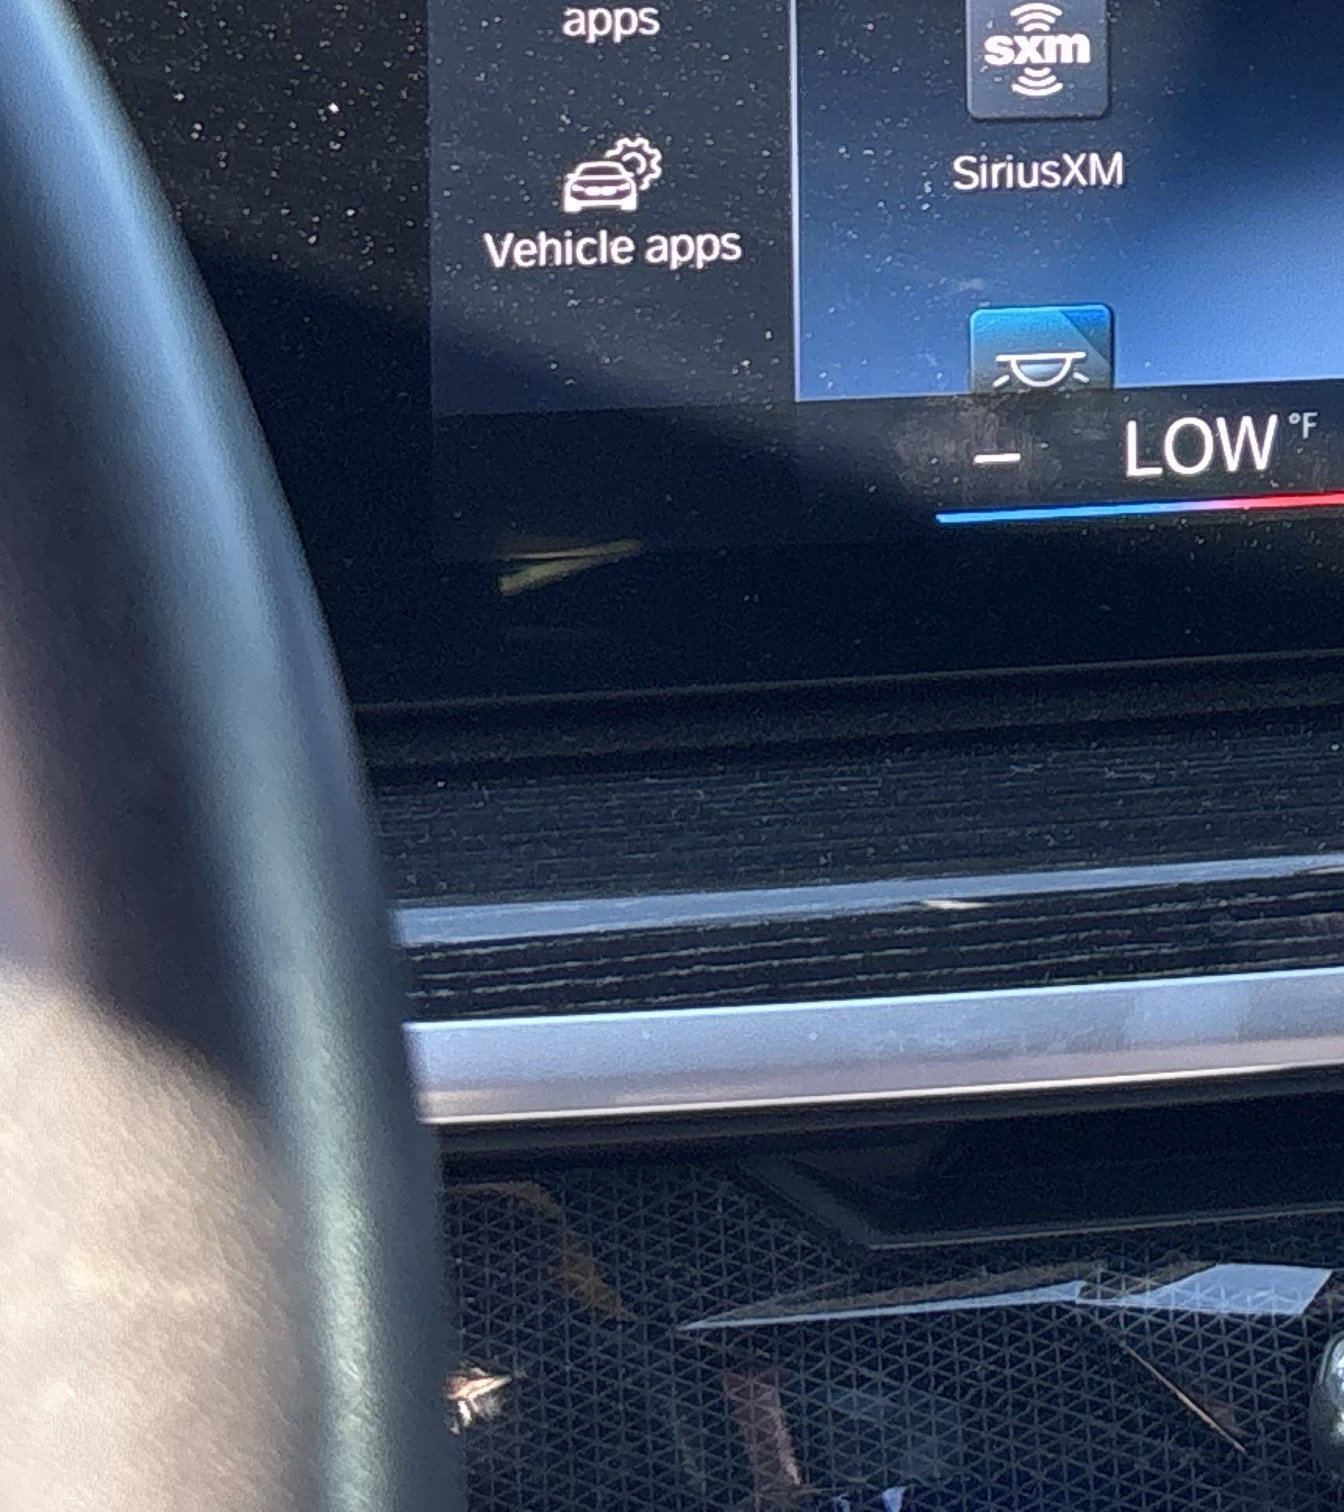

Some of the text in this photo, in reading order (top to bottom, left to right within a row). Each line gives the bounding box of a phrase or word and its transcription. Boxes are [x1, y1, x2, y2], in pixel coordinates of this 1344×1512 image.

[562, 4, 660, 43] apps
[984, 31, 1091, 65] sxm
[953, 152, 1124, 192] SiriusXM
[484, 230, 742, 270] Vehicle apps
[1125, 416, 1278, 478] LOW
